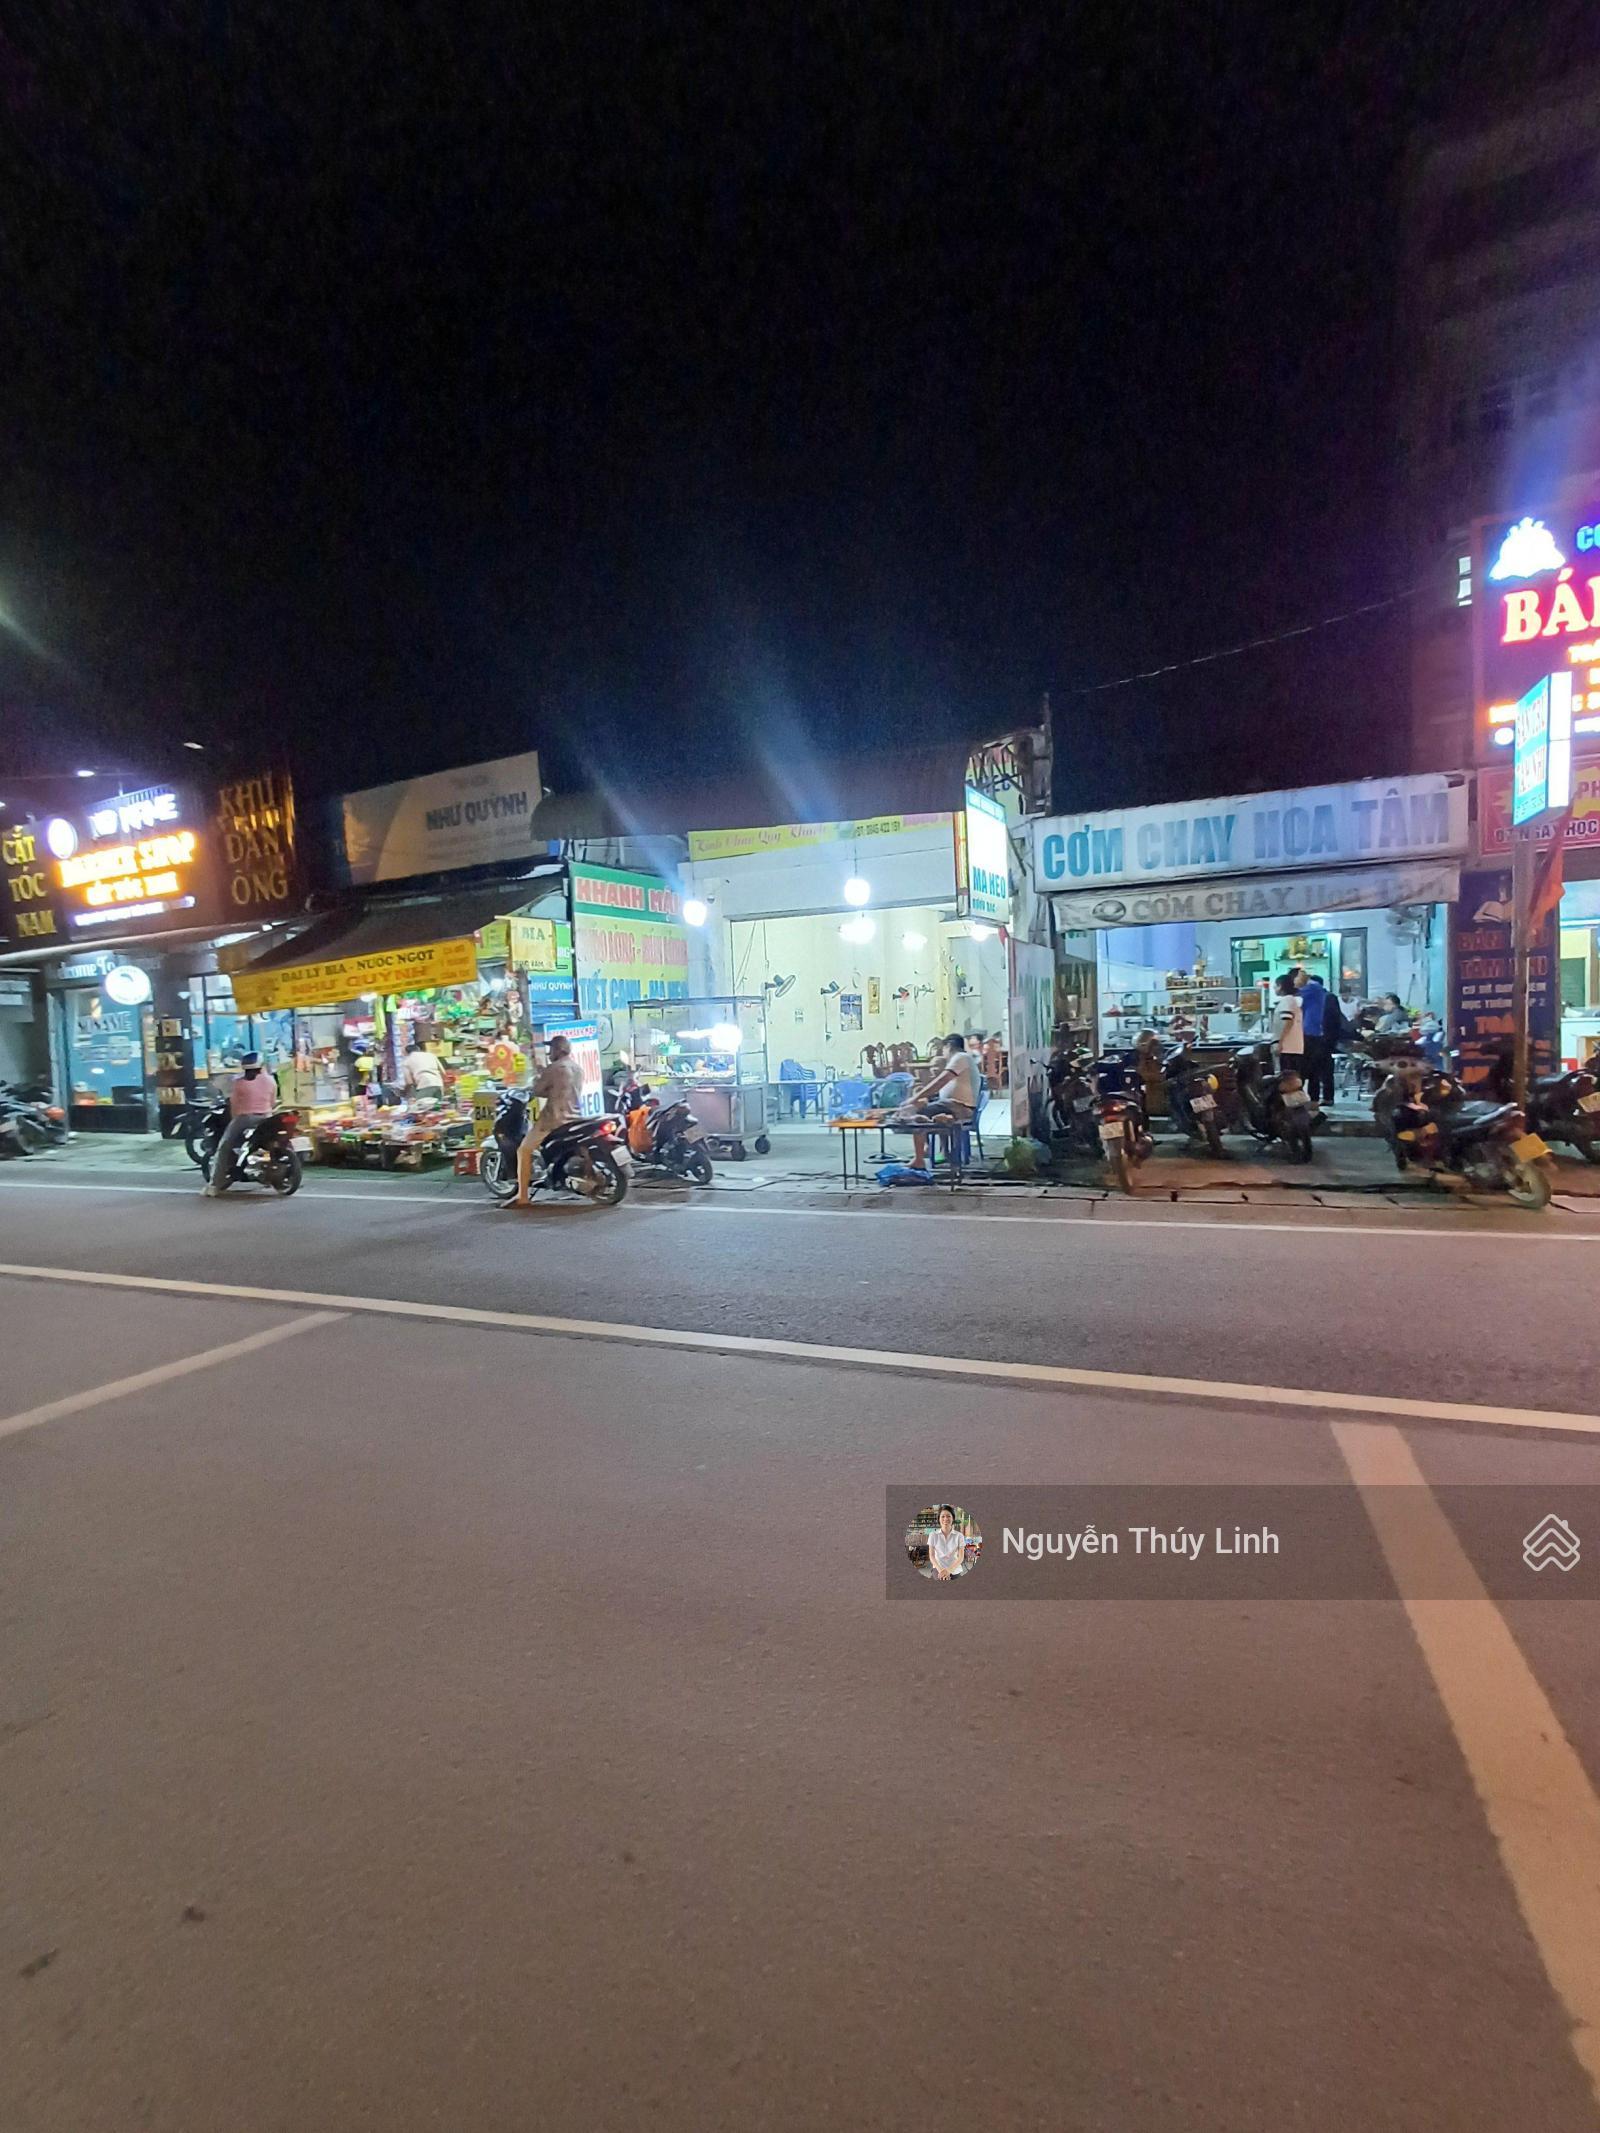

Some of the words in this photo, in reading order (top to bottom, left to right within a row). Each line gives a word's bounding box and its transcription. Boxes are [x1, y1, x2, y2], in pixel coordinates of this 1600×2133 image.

[1043, 824, 1123, 880] CƠM
[1137, 814, 1236, 870] CHAY
[1254, 805, 1338, 859] HOA
[1351, 788, 1450, 851] TÂM
[1132, 893, 1195, 921] CƠM
[1204, 884, 1294, 916] CHAY
